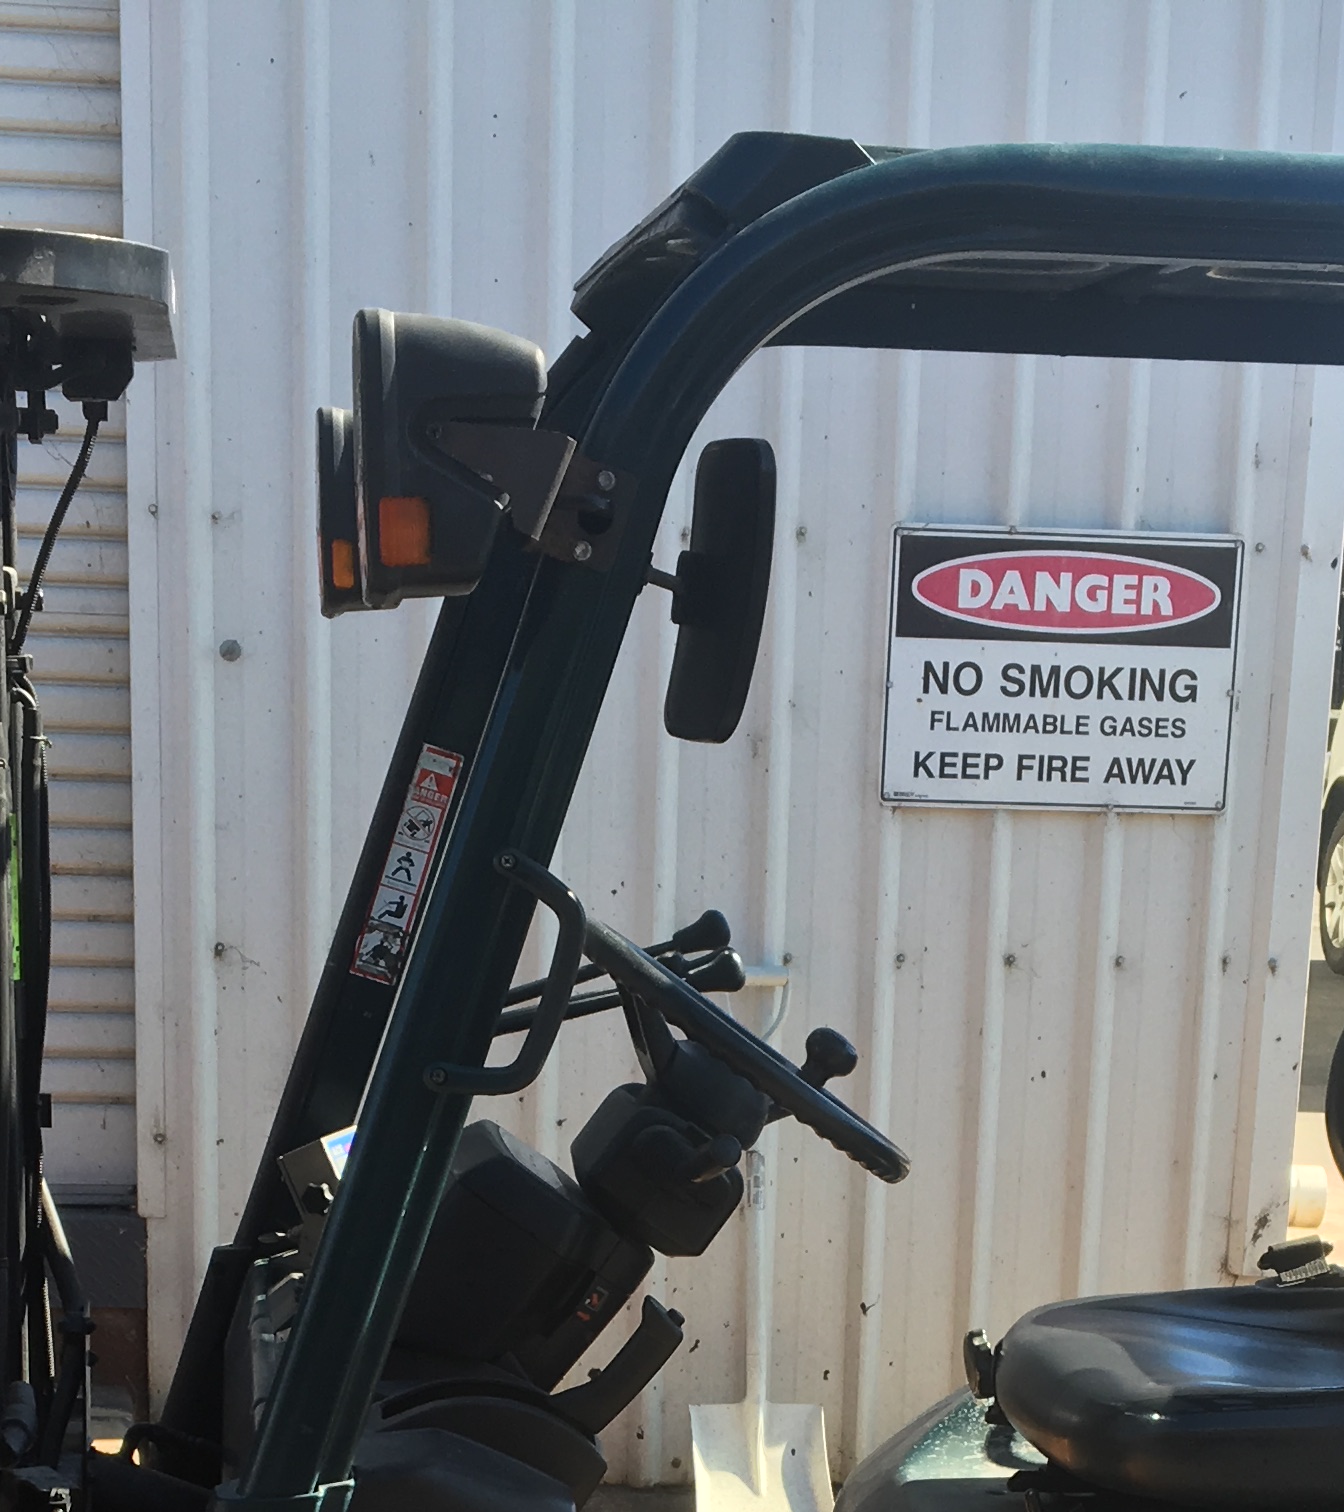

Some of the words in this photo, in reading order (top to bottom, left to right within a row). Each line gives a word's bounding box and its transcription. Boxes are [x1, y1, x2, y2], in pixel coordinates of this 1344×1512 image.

[957, 568, 1174, 616] DANGER
[921, 660, 984, 697] NO
[999, 663, 1199, 704] SMOKING
[929, 710, 1091, 737] FLAMMABLE
[1099, 716, 1187, 739] GASES
[912, 750, 1004, 782] KEEP
[1016, 754, 1091, 784] FIRE
[1103, 757, 1197, 786] AWAY
[409, 785, 450, 805] ANGER
